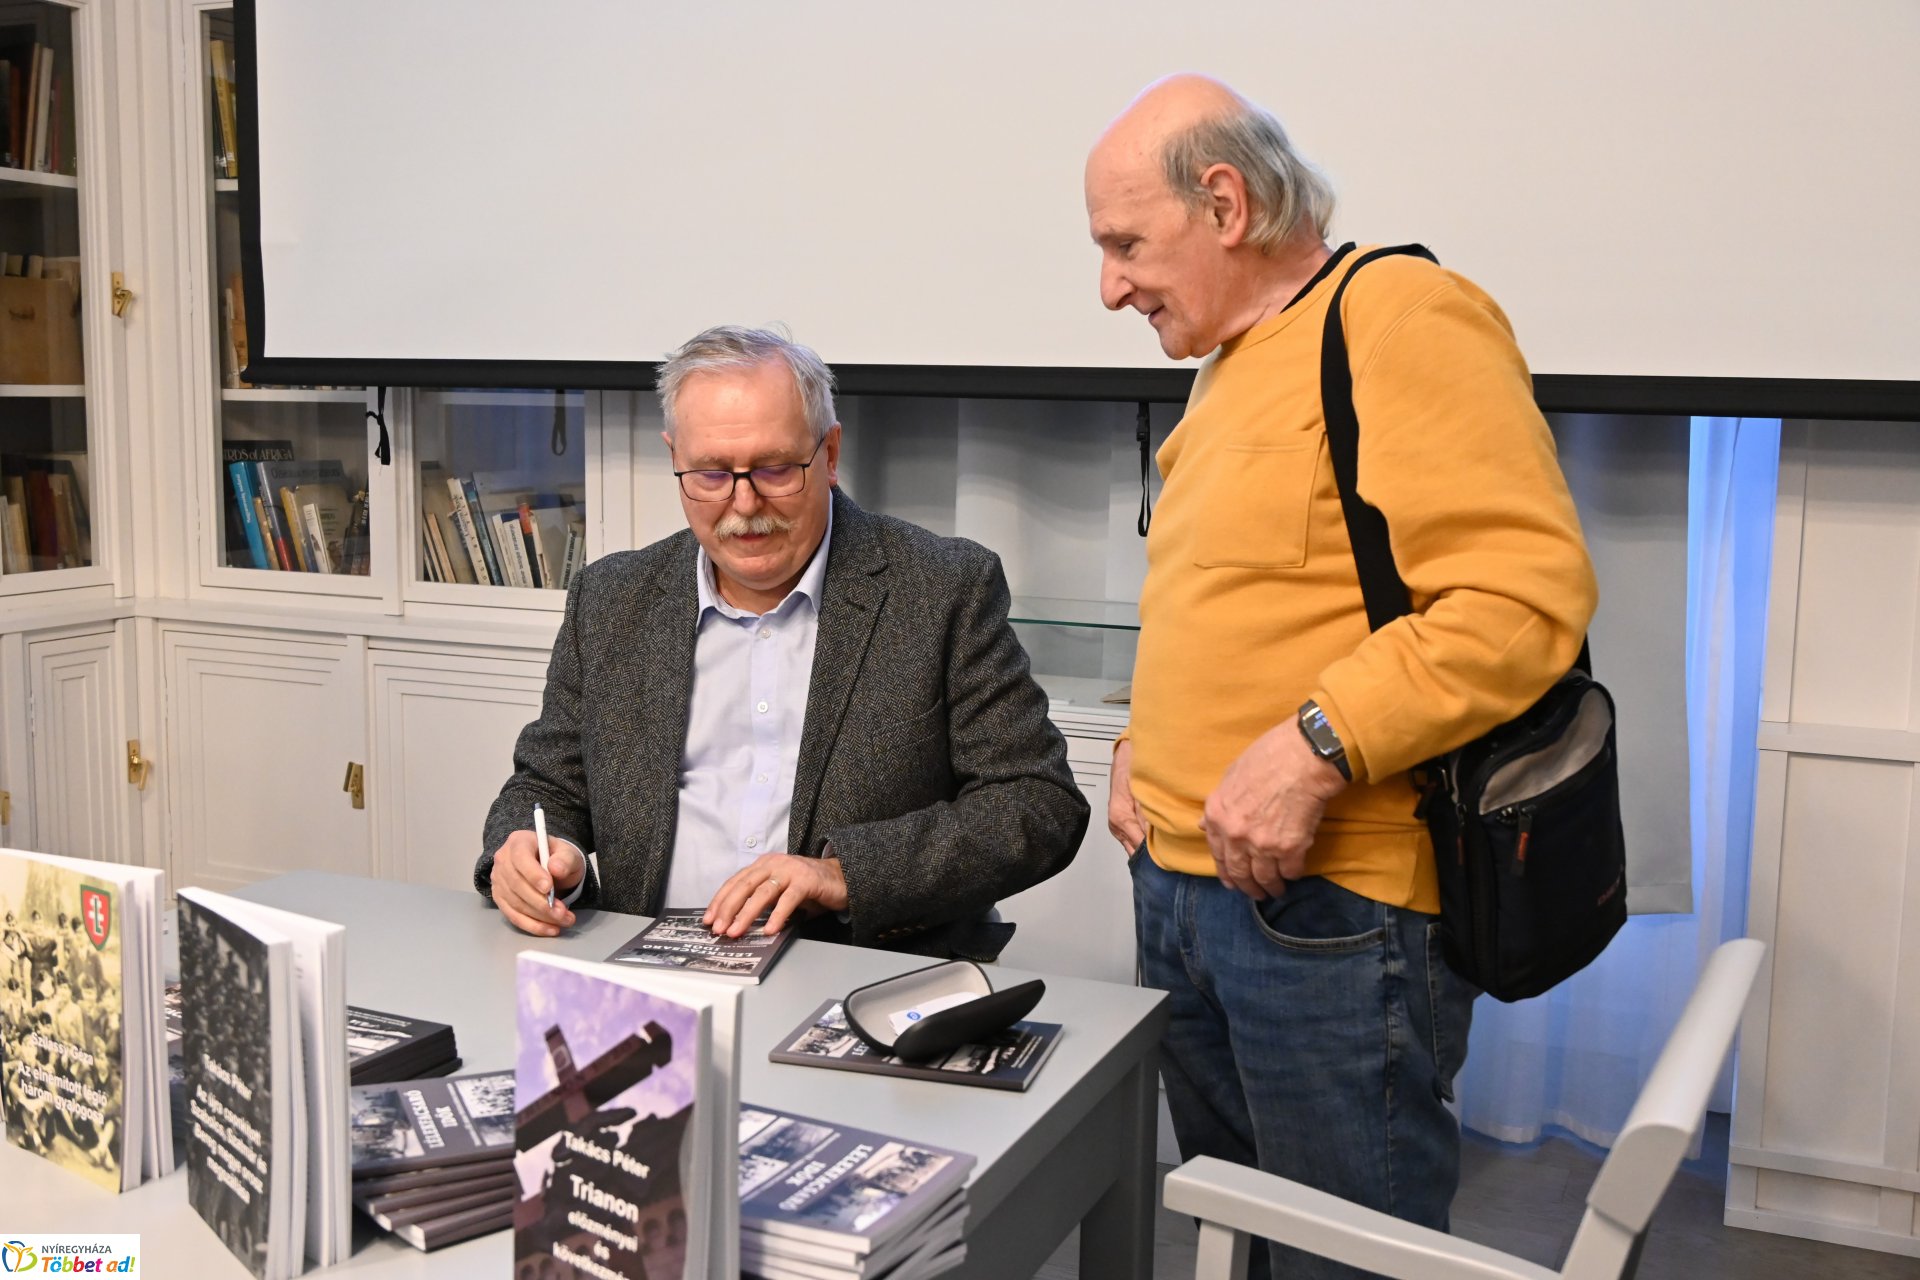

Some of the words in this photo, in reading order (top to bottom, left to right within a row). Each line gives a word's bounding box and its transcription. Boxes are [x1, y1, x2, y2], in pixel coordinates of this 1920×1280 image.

[224, 449, 248, 460] IRDS
[260, 448, 293, 461] AFRICA
[72, 1045, 93, 1066] Géza
[18, 1061, 31, 1078] Az
[21, 1079, 54, 1102] három
[196, 1084, 208, 1103] Az
[562, 1130, 611, 1164] Takács
[613, 1149, 650, 1179] Péter
[569, 1173, 639, 1223] Trianon
[567, 1210, 638, 1253] előzményei
[593, 1240, 610, 1261] és
